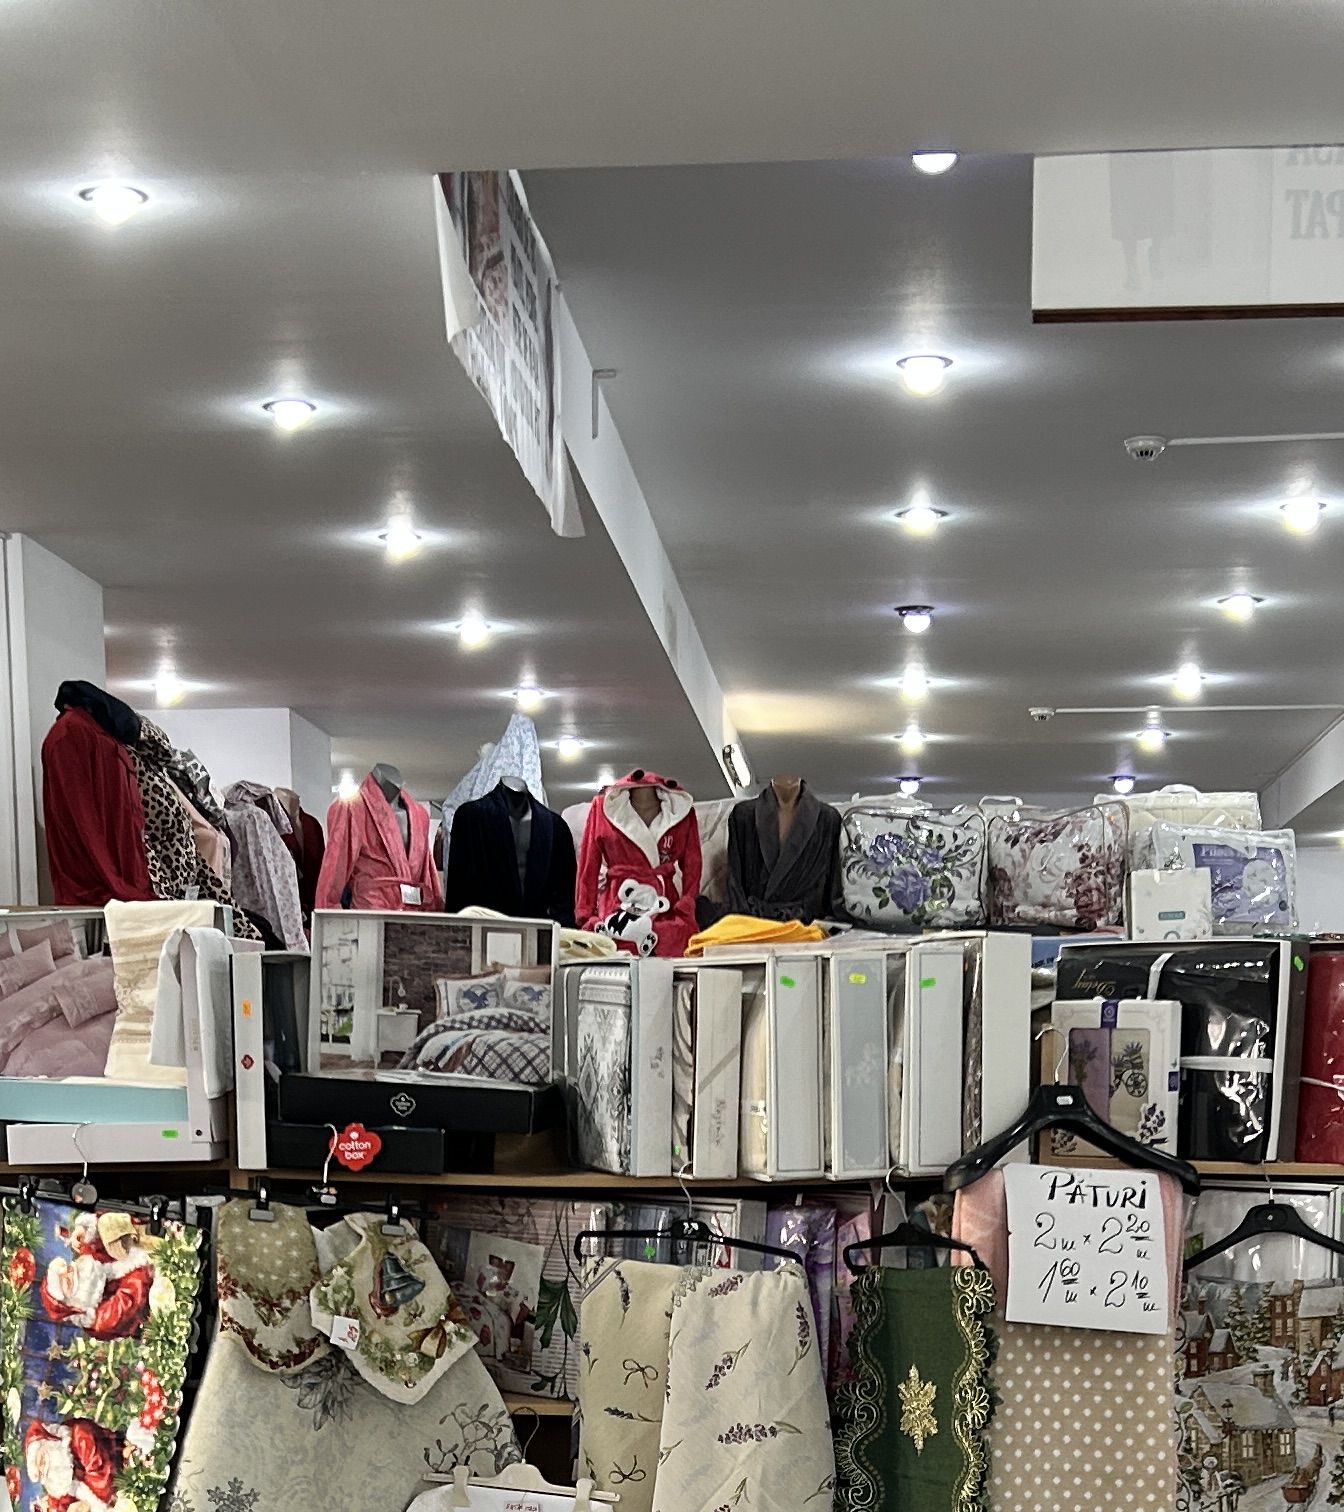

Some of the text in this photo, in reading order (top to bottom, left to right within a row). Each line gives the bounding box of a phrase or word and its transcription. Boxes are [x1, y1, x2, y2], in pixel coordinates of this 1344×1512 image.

[338, 1141, 372, 1151] cotton
[344, 1150, 365, 1160] box
[1040, 1170, 1147, 1209] PĂTURI
